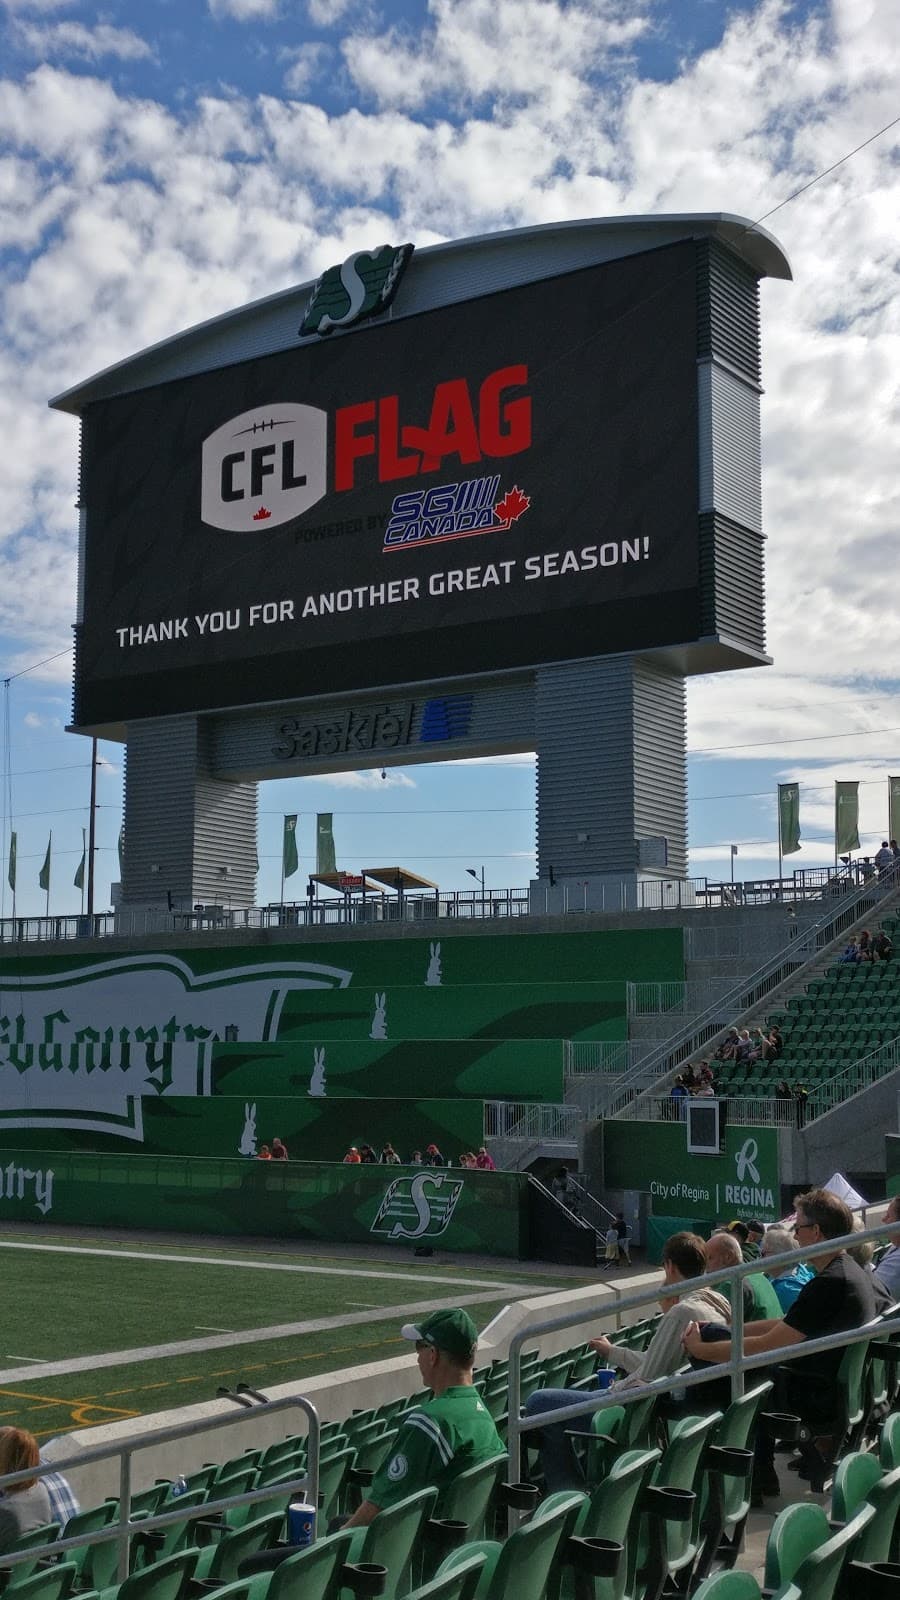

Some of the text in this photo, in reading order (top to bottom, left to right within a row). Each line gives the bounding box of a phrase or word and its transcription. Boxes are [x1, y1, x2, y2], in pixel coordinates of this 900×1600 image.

[317, 244, 389, 332] S
[335, 364, 533, 493] FLAG
[220, 439, 308, 503] CFL
[383, 506, 494, 546] CANADA
[116, 535, 651, 649] THANK YOU FOR ANOTHER GREAT SEASON!
[272, 703, 415, 759] SaskTel
[650, 1180, 710, 1202] City of Regina
[725, 1185, 775, 1208] REGINA
